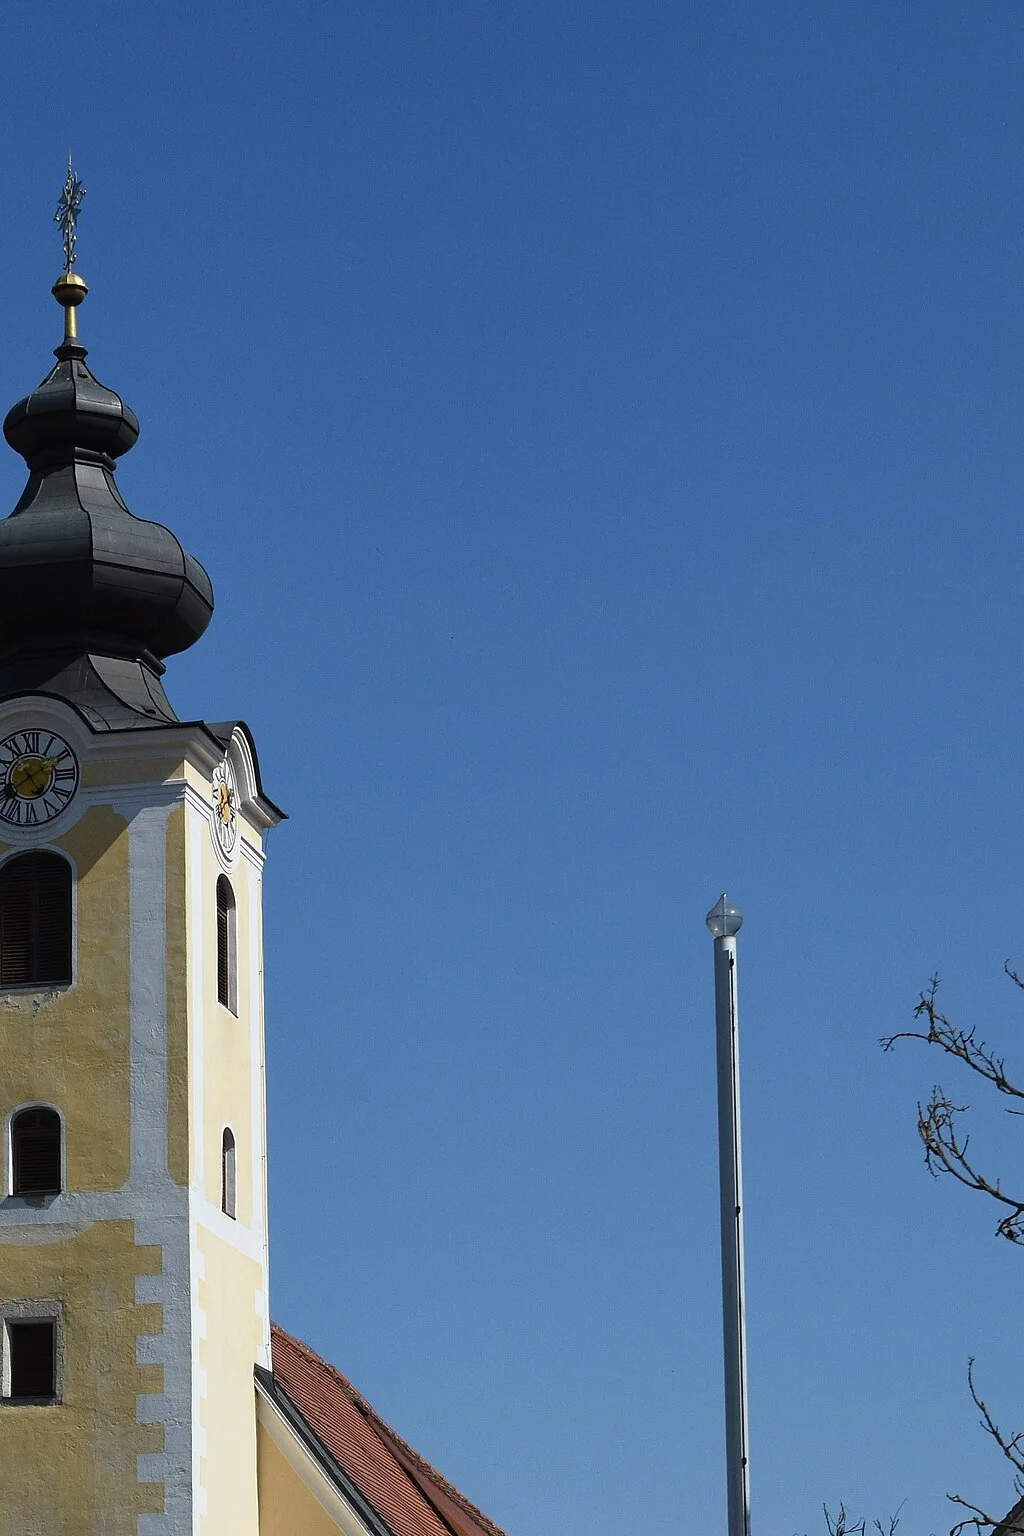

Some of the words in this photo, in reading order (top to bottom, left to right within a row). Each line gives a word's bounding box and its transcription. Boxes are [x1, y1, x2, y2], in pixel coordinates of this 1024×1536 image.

[2, 736, 23, 760] XI
[21, 732, 41, 753] XII
[55, 765, 75, 783] III
